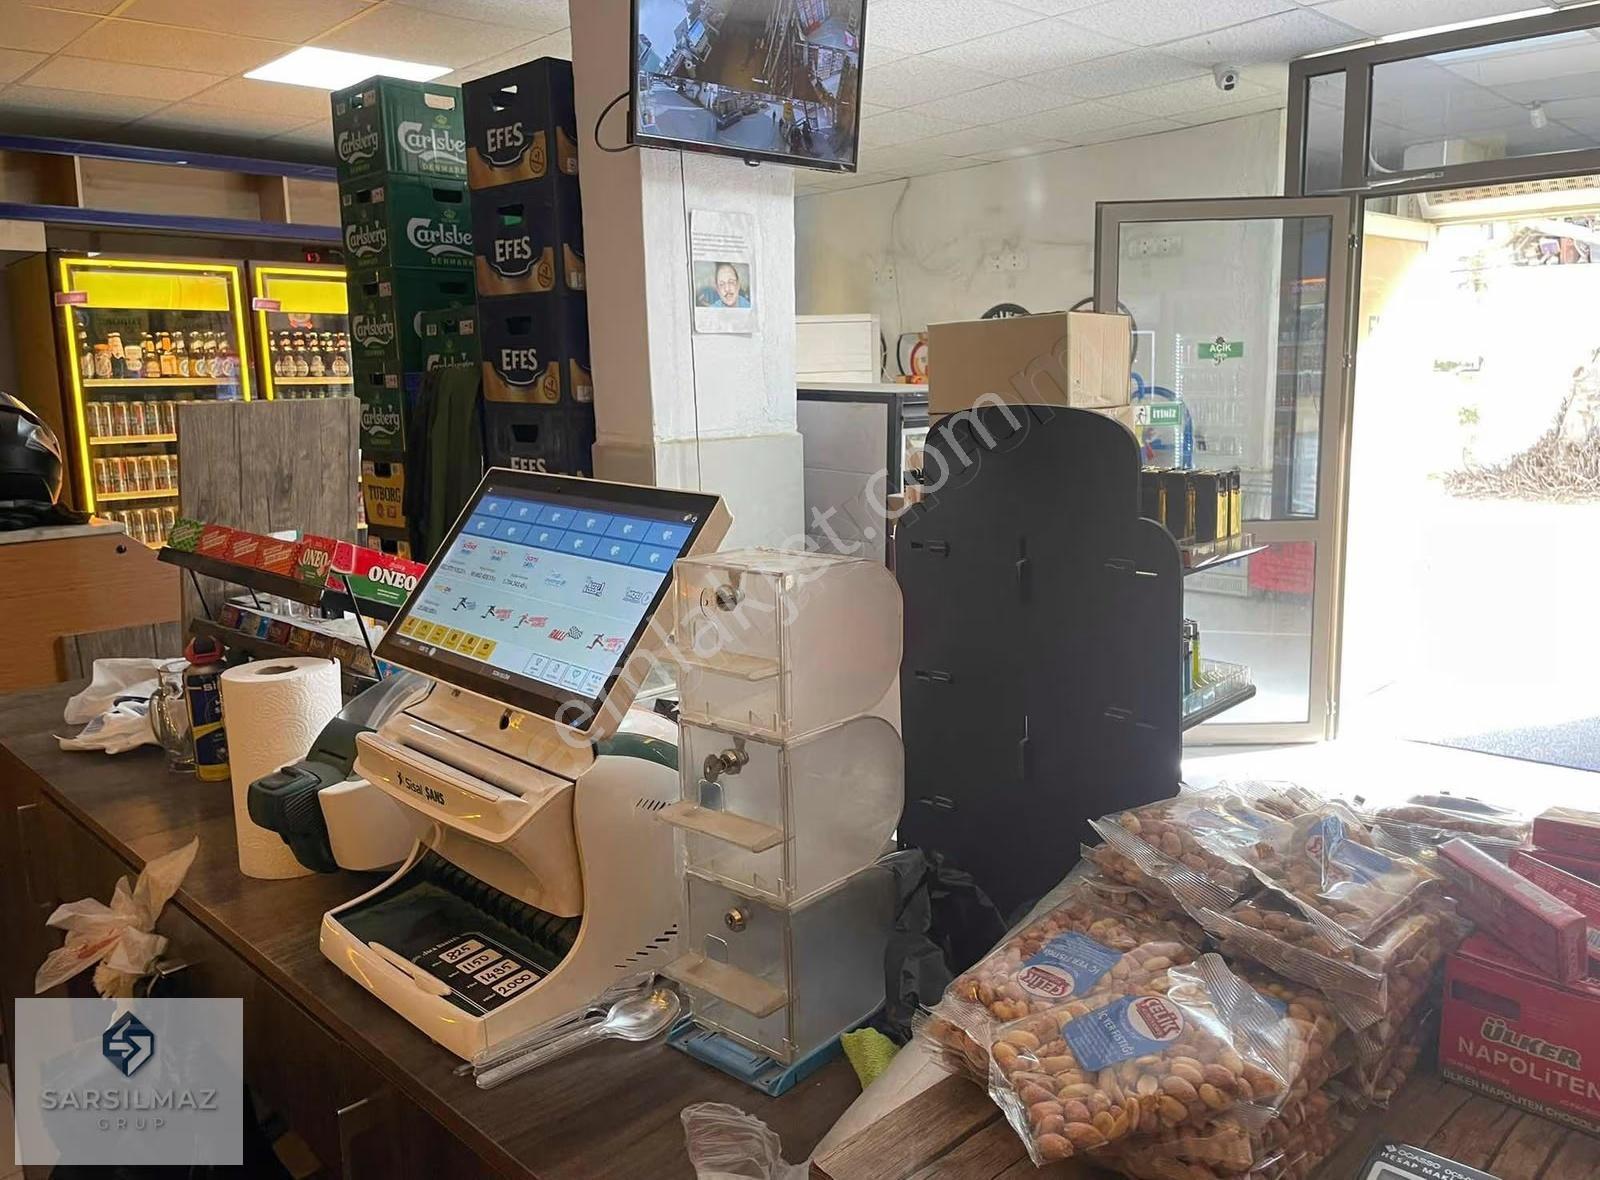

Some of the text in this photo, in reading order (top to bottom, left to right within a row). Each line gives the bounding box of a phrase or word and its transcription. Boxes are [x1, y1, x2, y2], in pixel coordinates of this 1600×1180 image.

[337, 124, 379, 164] Carlsberg
[397, 120, 466, 154] Carlsbe
[486, 122, 524, 153] EFES
[345, 220, 387, 258] Carlsberg
[406, 217, 473, 248] Carlsbe
[494, 236, 531, 263] EFES
[352, 313, 394, 348] Carlsberg
[500, 348, 538, 372] EFES
[360, 403, 400, 435] Carlsberg
[368, 484, 402, 503] TUBORG
[303, 548, 329, 567] ONEO
[368, 565, 418, 591] ONEO
[405, 777, 423, 795] Sisal
[446, 943, 472, 961] 825
[462, 955, 490, 972] 1150
[497, 973, 531, 995] 2000
[1480, 1016, 1582, 1071] ÜLKER
[1381, 1151, 1418, 1168] HESAP
[1398, 1149, 1441, 1169] OCASSO
